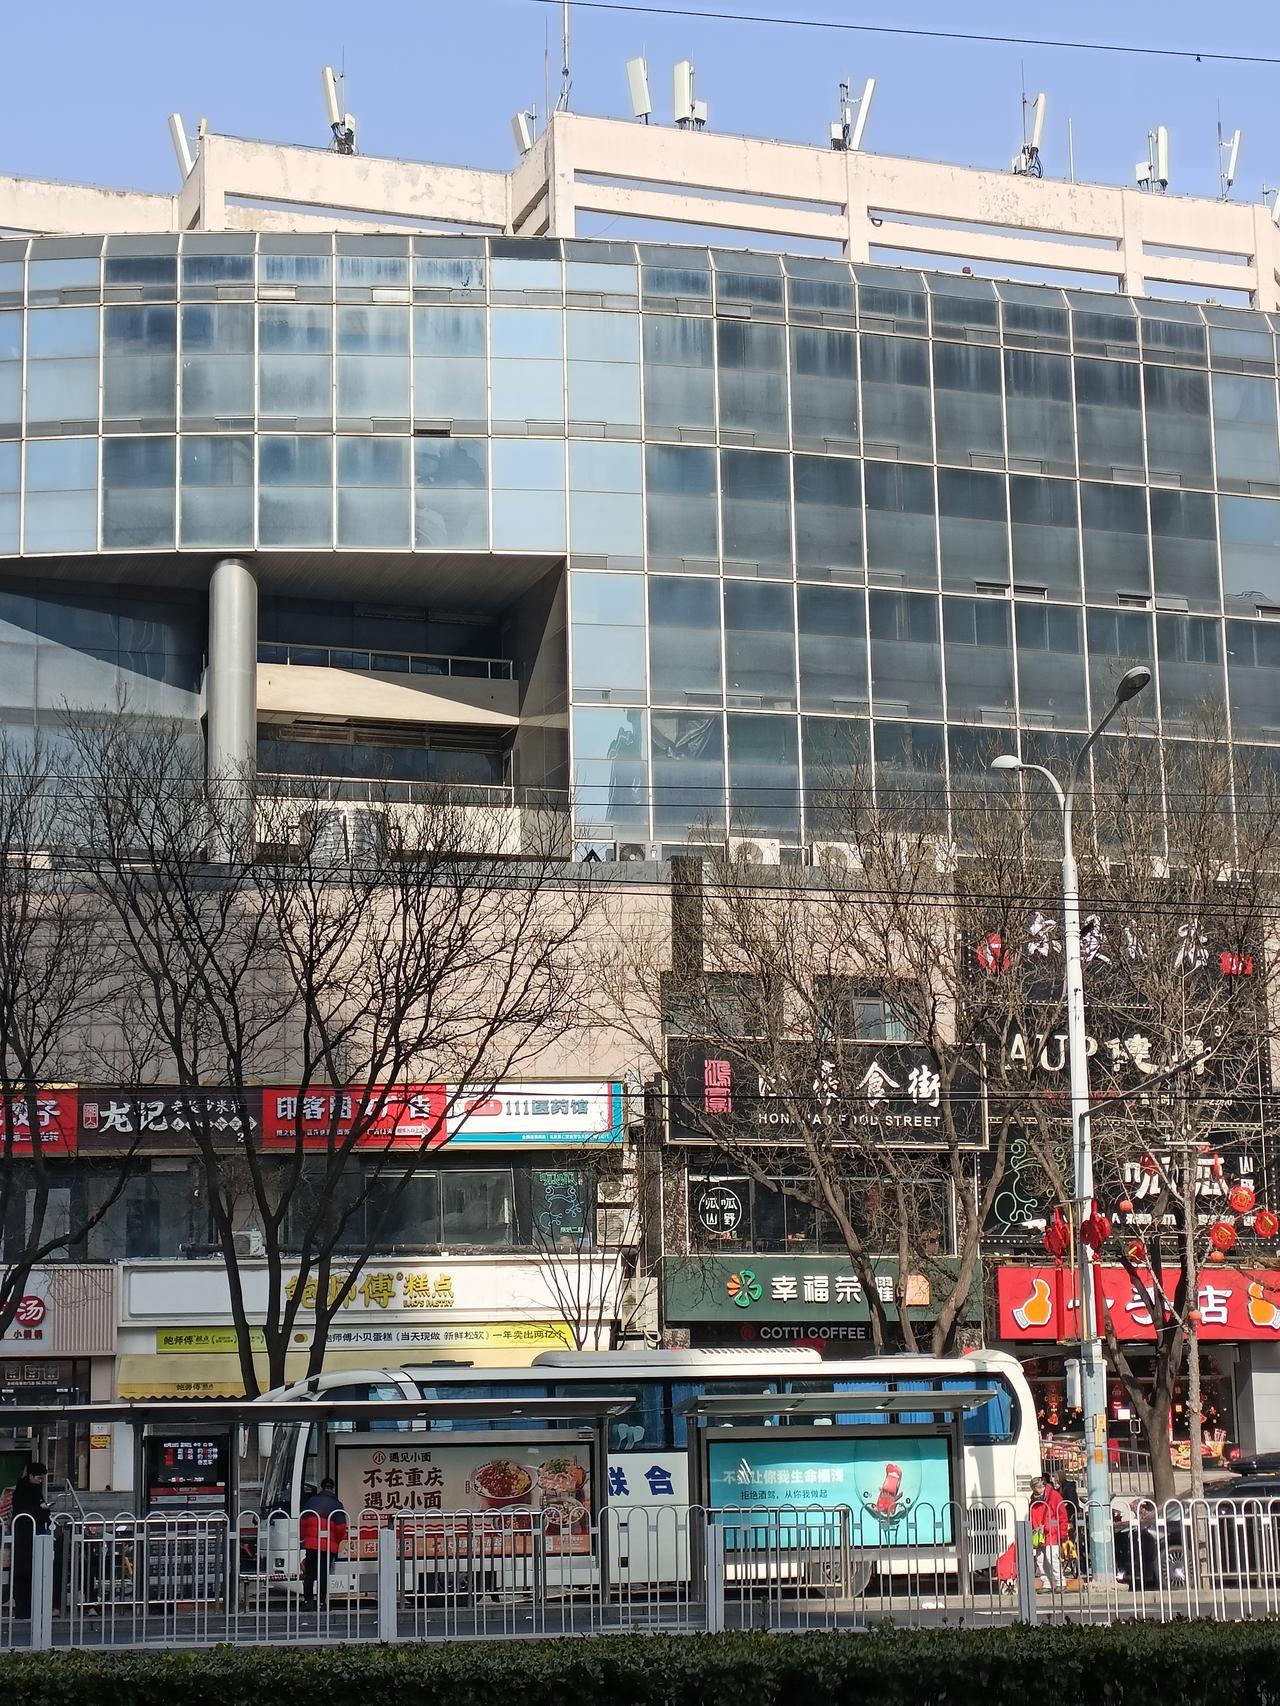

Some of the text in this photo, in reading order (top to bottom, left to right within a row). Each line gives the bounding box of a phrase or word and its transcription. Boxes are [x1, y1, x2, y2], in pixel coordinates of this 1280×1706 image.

[0, 1099, 61, 1127] 饺子
[98, 1100, 169, 1133] 龙记
[505, 1098, 589, 1116] 111医药馆
[884, 1115, 941, 1127] STREET
[705, 1213, 736, 1227] 山野
[403, 1272, 454, 1299] 糕点
[17, 1300, 44, 1321] 汤
[760, 1326, 866, 1340] COTTI COFFEE
[389, 1452, 432, 1463] 遇见小面
[362, 1467, 445, 1489] 不在重庆
[363, 1490, 444, 1511] 遇见小面
[740, 1488, 828, 1500] 拒绝酒驾，从你我做起
